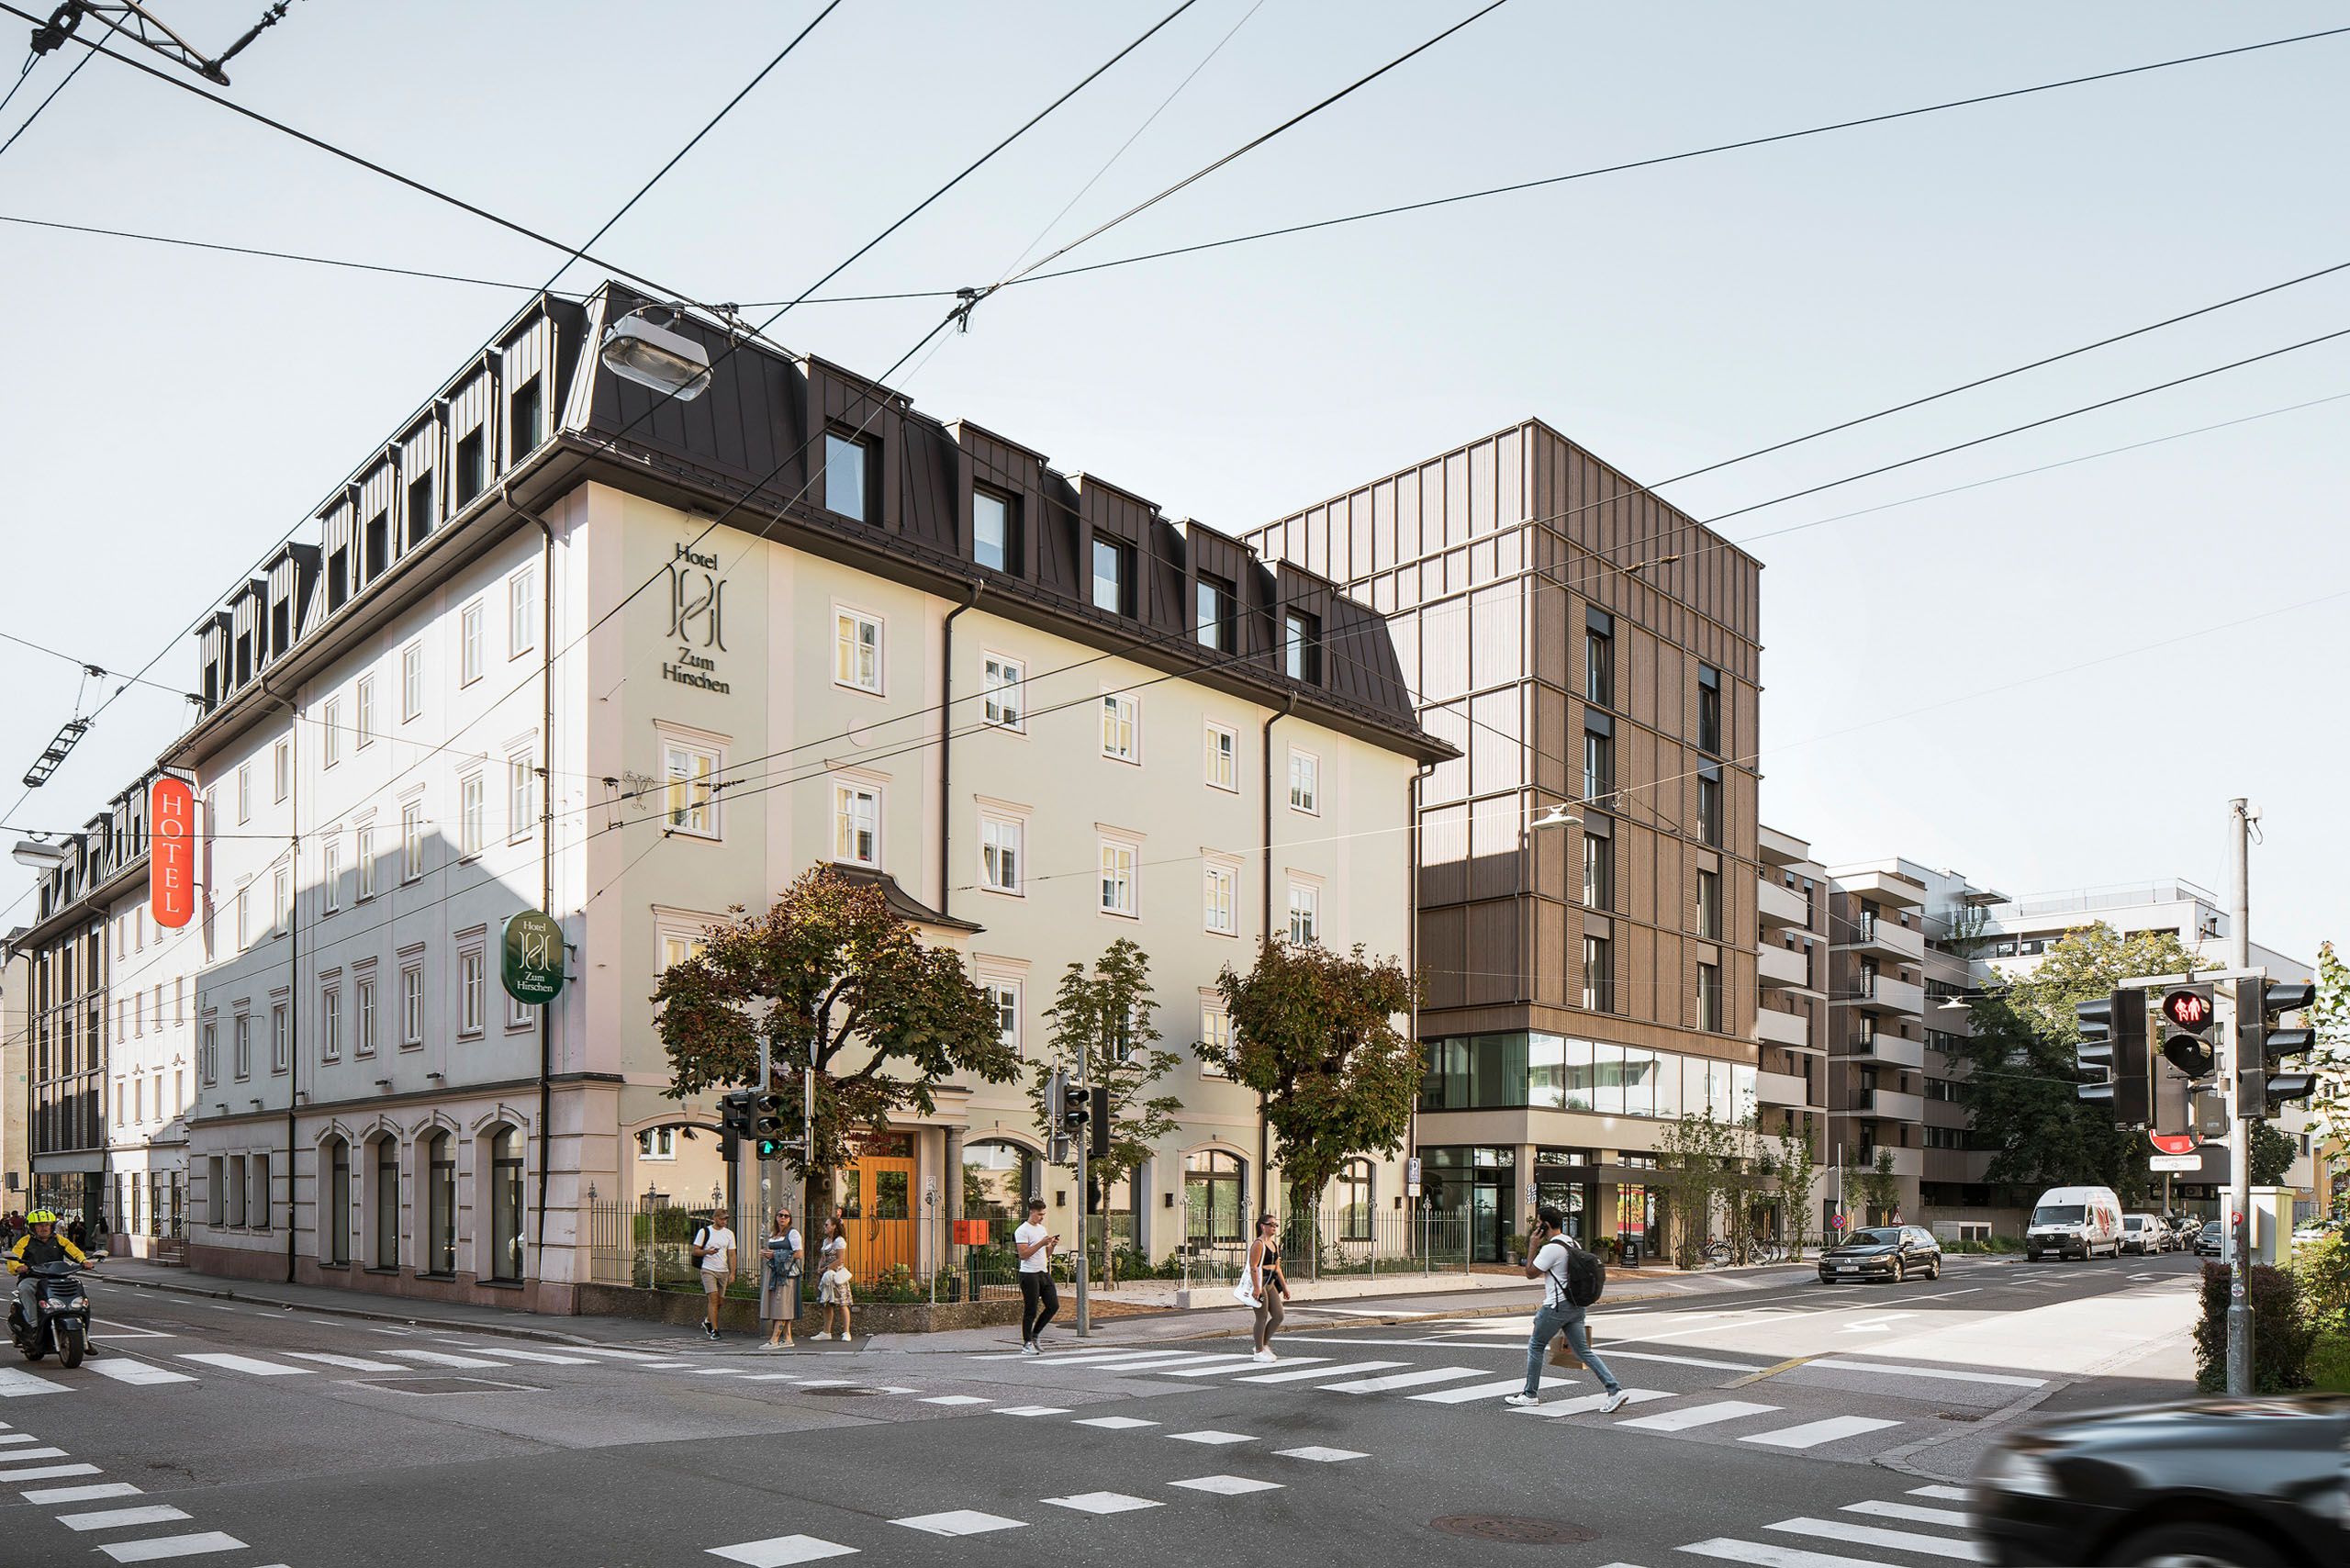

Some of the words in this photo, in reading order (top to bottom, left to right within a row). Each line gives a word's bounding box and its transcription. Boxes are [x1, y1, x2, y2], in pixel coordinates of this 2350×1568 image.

[676, 543, 718, 571] Hotel
[678, 646, 715, 671] Zum
[662, 662, 731, 695] Hirschen
[160, 793, 184, 913] HOTEL
[523, 921, 546, 932] Hotel
[517, 980, 553, 992] Hirschen
[525, 971, 545, 981] Zum
